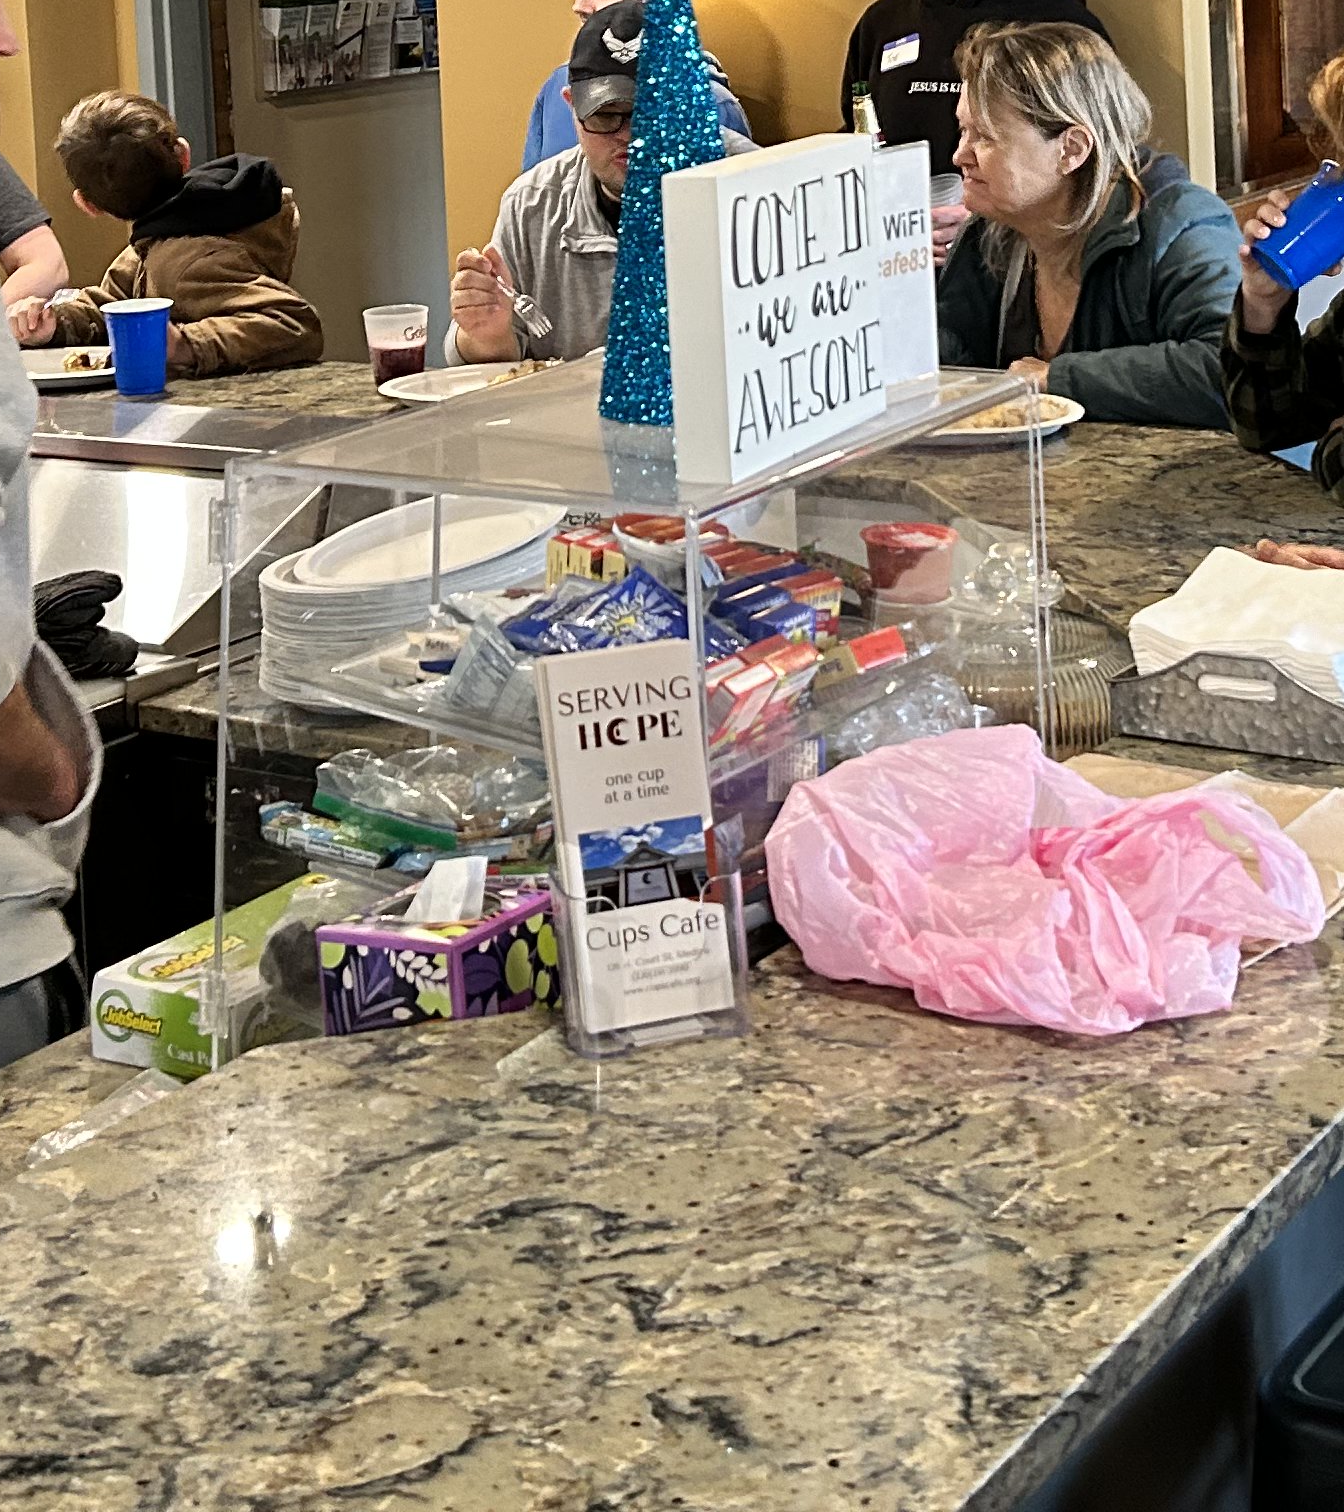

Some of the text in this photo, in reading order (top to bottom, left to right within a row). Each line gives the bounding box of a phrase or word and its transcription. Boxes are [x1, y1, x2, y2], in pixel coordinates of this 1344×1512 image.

[908, 81, 938, 94] JESUS
[938, 81, 950, 93] IS
[730, 165, 871, 290] COME IN
[883, 208, 926, 241] WiFi
[757, 275, 853, 347] we are
[734, 320, 883, 454] AWESOME
[557, 674, 693, 718] SERVING
[604, 782, 670, 805] at a time
[605, 767, 665, 788] one cup
[586, 908, 720, 953] Cups Cafe
[102, 1004, 163, 1037] JobSelect
